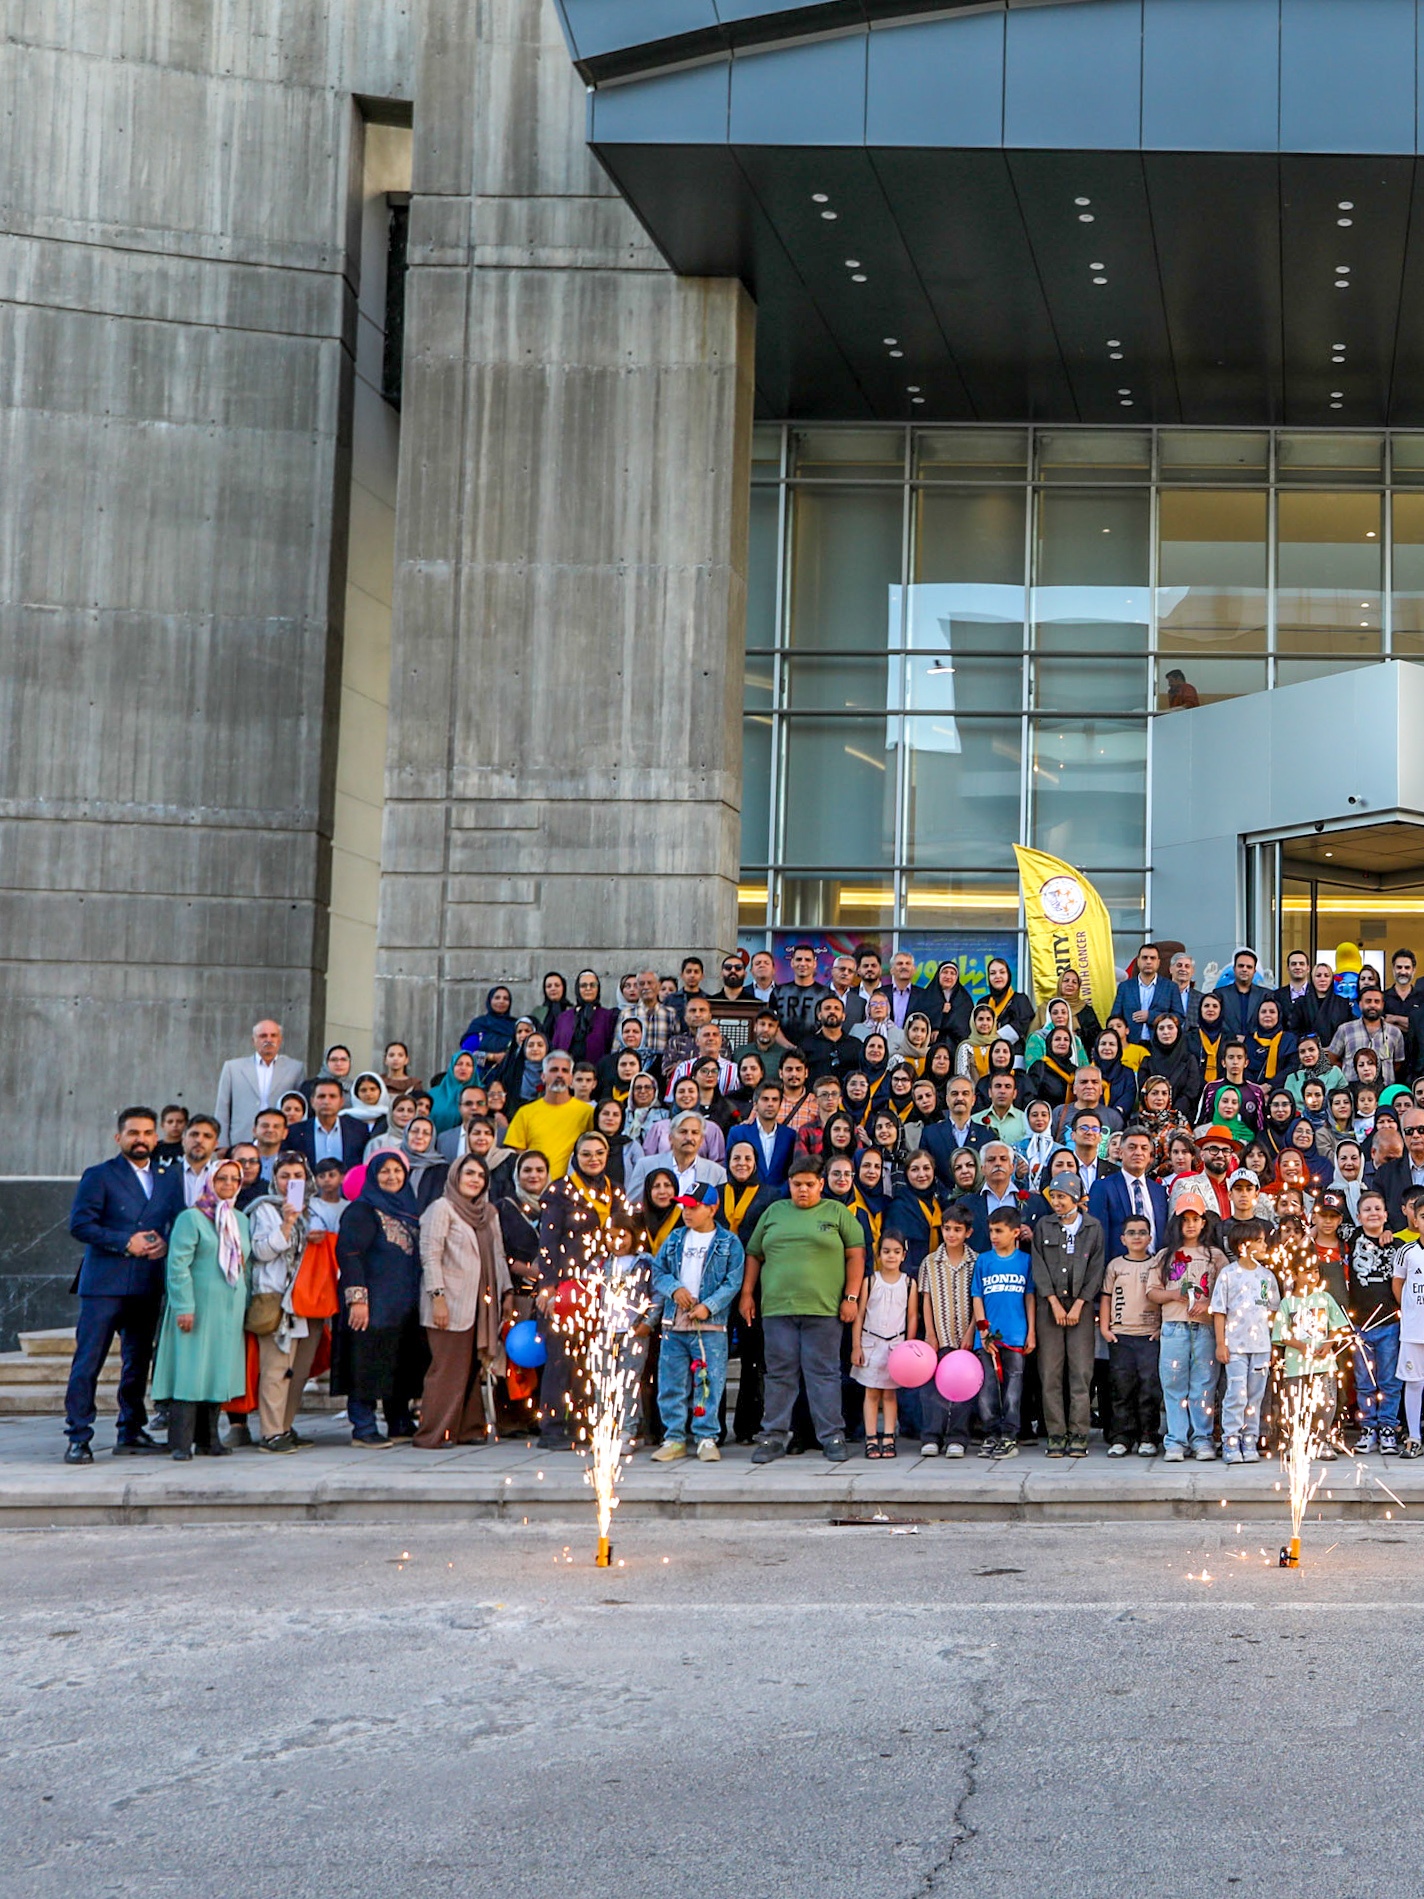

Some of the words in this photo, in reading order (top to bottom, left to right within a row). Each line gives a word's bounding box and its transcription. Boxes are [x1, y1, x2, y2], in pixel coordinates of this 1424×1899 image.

[1076, 931, 1089, 969] CANCER
[1080, 970, 1092, 998] WITH
[982, 1273, 1026, 1287] HONDA
